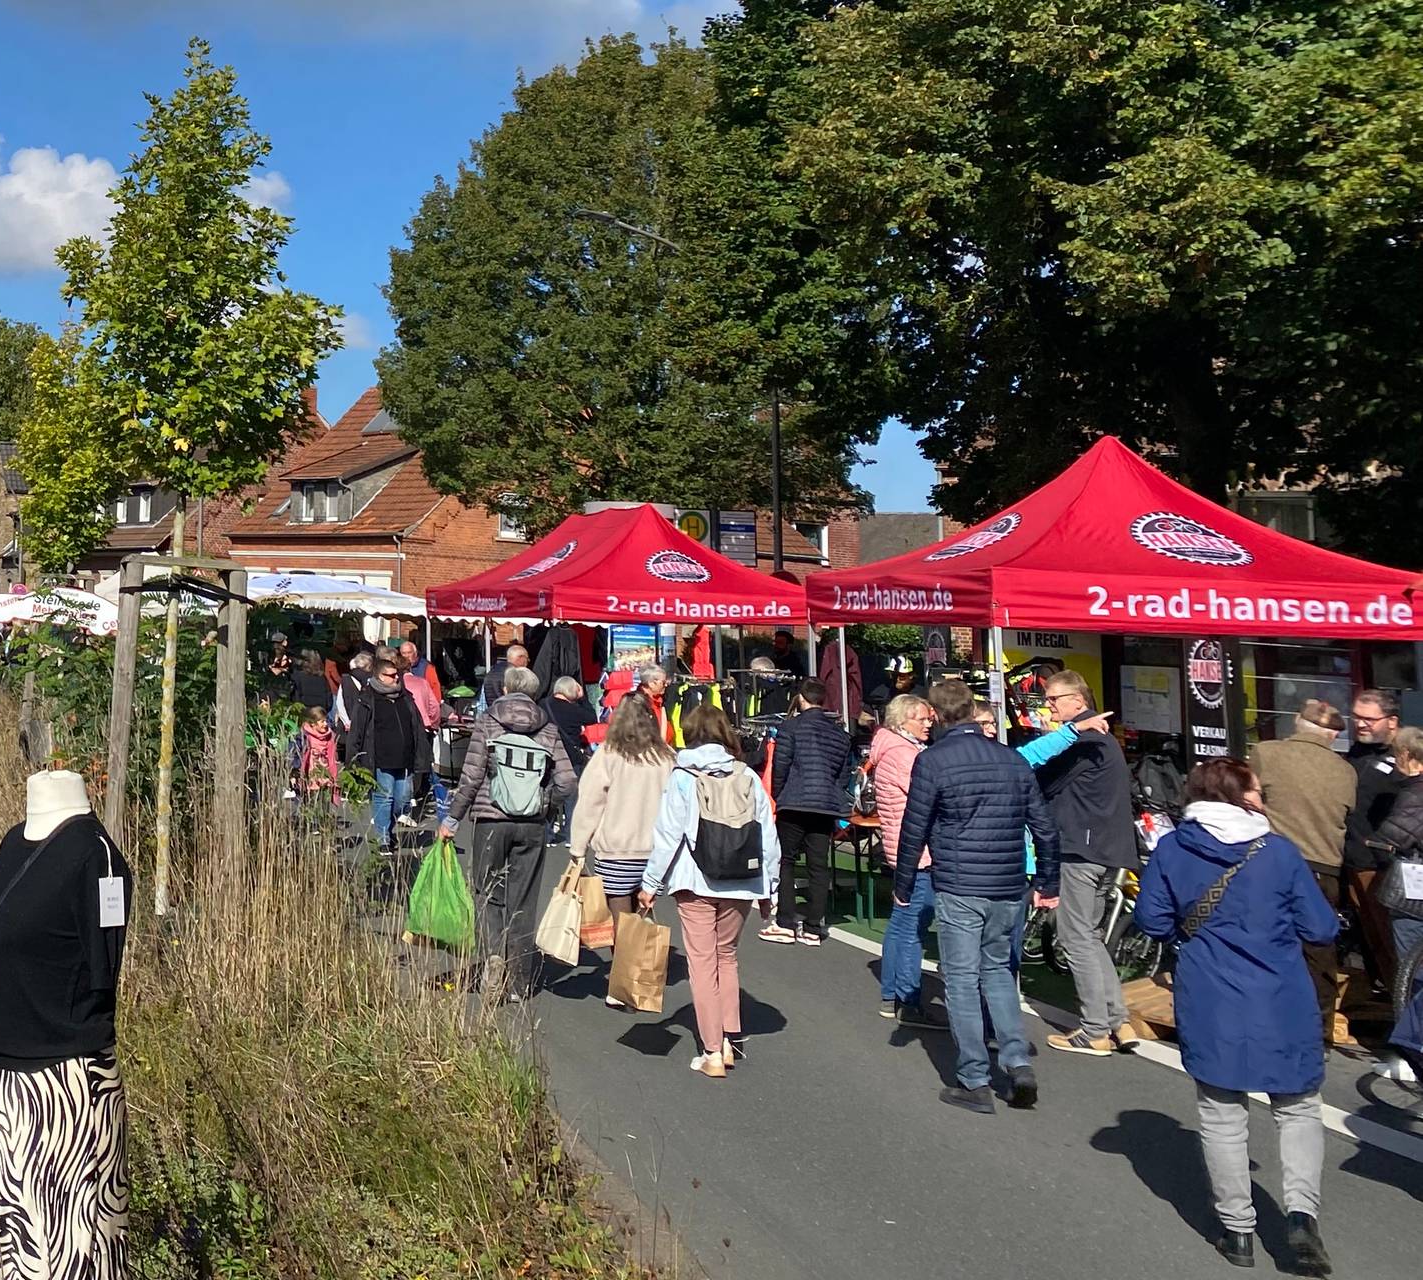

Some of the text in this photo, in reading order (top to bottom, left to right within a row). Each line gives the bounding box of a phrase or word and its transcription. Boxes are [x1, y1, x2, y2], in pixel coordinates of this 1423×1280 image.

[1143, 533, 1240, 554] HANSEN
[653, 561, 706, 576] HANSEN
[460, 593, 507, 612] 2-rad-hansen.de
[606, 595, 792, 619] 2-rad-hansen.de
[832, 583, 954, 611] 2-rad-hansen.de
[1087, 585, 1414, 625] 2-rad-hansen.de
[1017, 631, 1073, 649] IM REGAL
